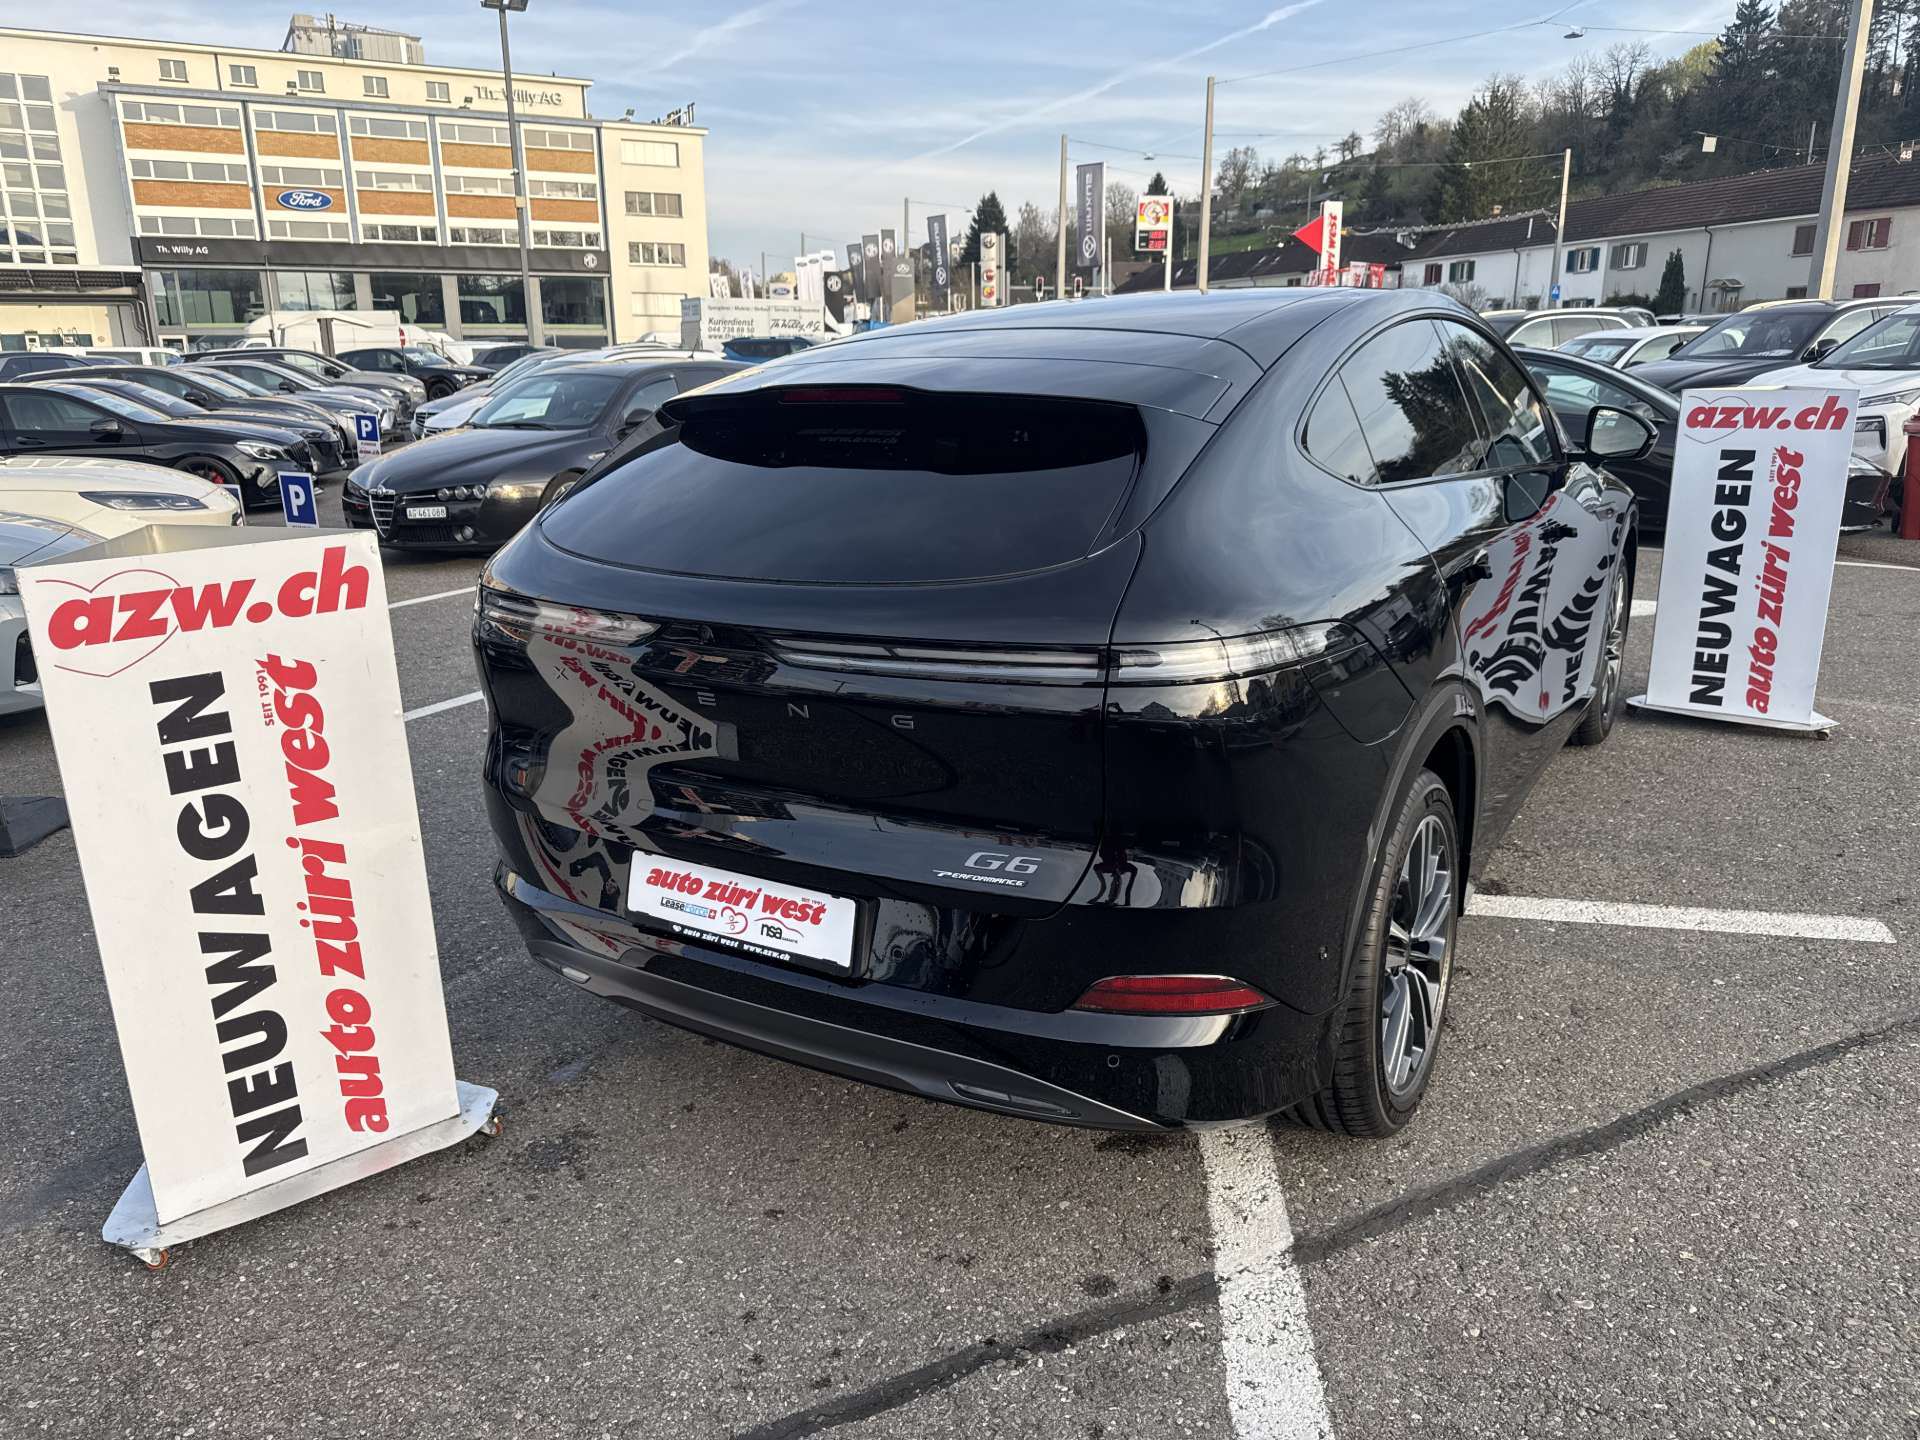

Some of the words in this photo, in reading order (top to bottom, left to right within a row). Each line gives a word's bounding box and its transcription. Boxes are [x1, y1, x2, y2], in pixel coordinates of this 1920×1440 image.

[538, 91, 562, 106] AG
[288, 191, 323, 207] Ford
[156, 245, 171, 255] Th.
[171, 245, 189, 256] Willy
[189, 247, 209, 256] AG
[360, 419, 373, 438] P
[1685, 395, 1849, 431] azw.ch
[287, 484, 306, 517] P
[1768, 445, 1804, 538] west
[1689, 449, 1757, 706] NEUWAGEN
[1754, 540, 1791, 627] züri
[47, 545, 370, 650] azw.ch
[256, 668, 269, 698] 1991
[1746, 626, 1778, 714] auto
[261, 701, 275, 727] SEIT
[255, 652, 340, 827] west
[932, 869, 1026, 887] PERFORMANCE
[964, 851, 1043, 874] G6
[285, 836, 366, 980] züri
[646, 868, 704, 896] auto
[701, 880, 763, 909] züri
[761, 893, 827, 926] west
[149, 671, 309, 1178] NEUWAGEN
[760, 923, 783, 940] nsa
[682, 928, 701, 938] auto
[720, 937, 739, 948] west
[743, 944, 791, 961] www.azw.ch
[319, 988, 390, 1133] auto
